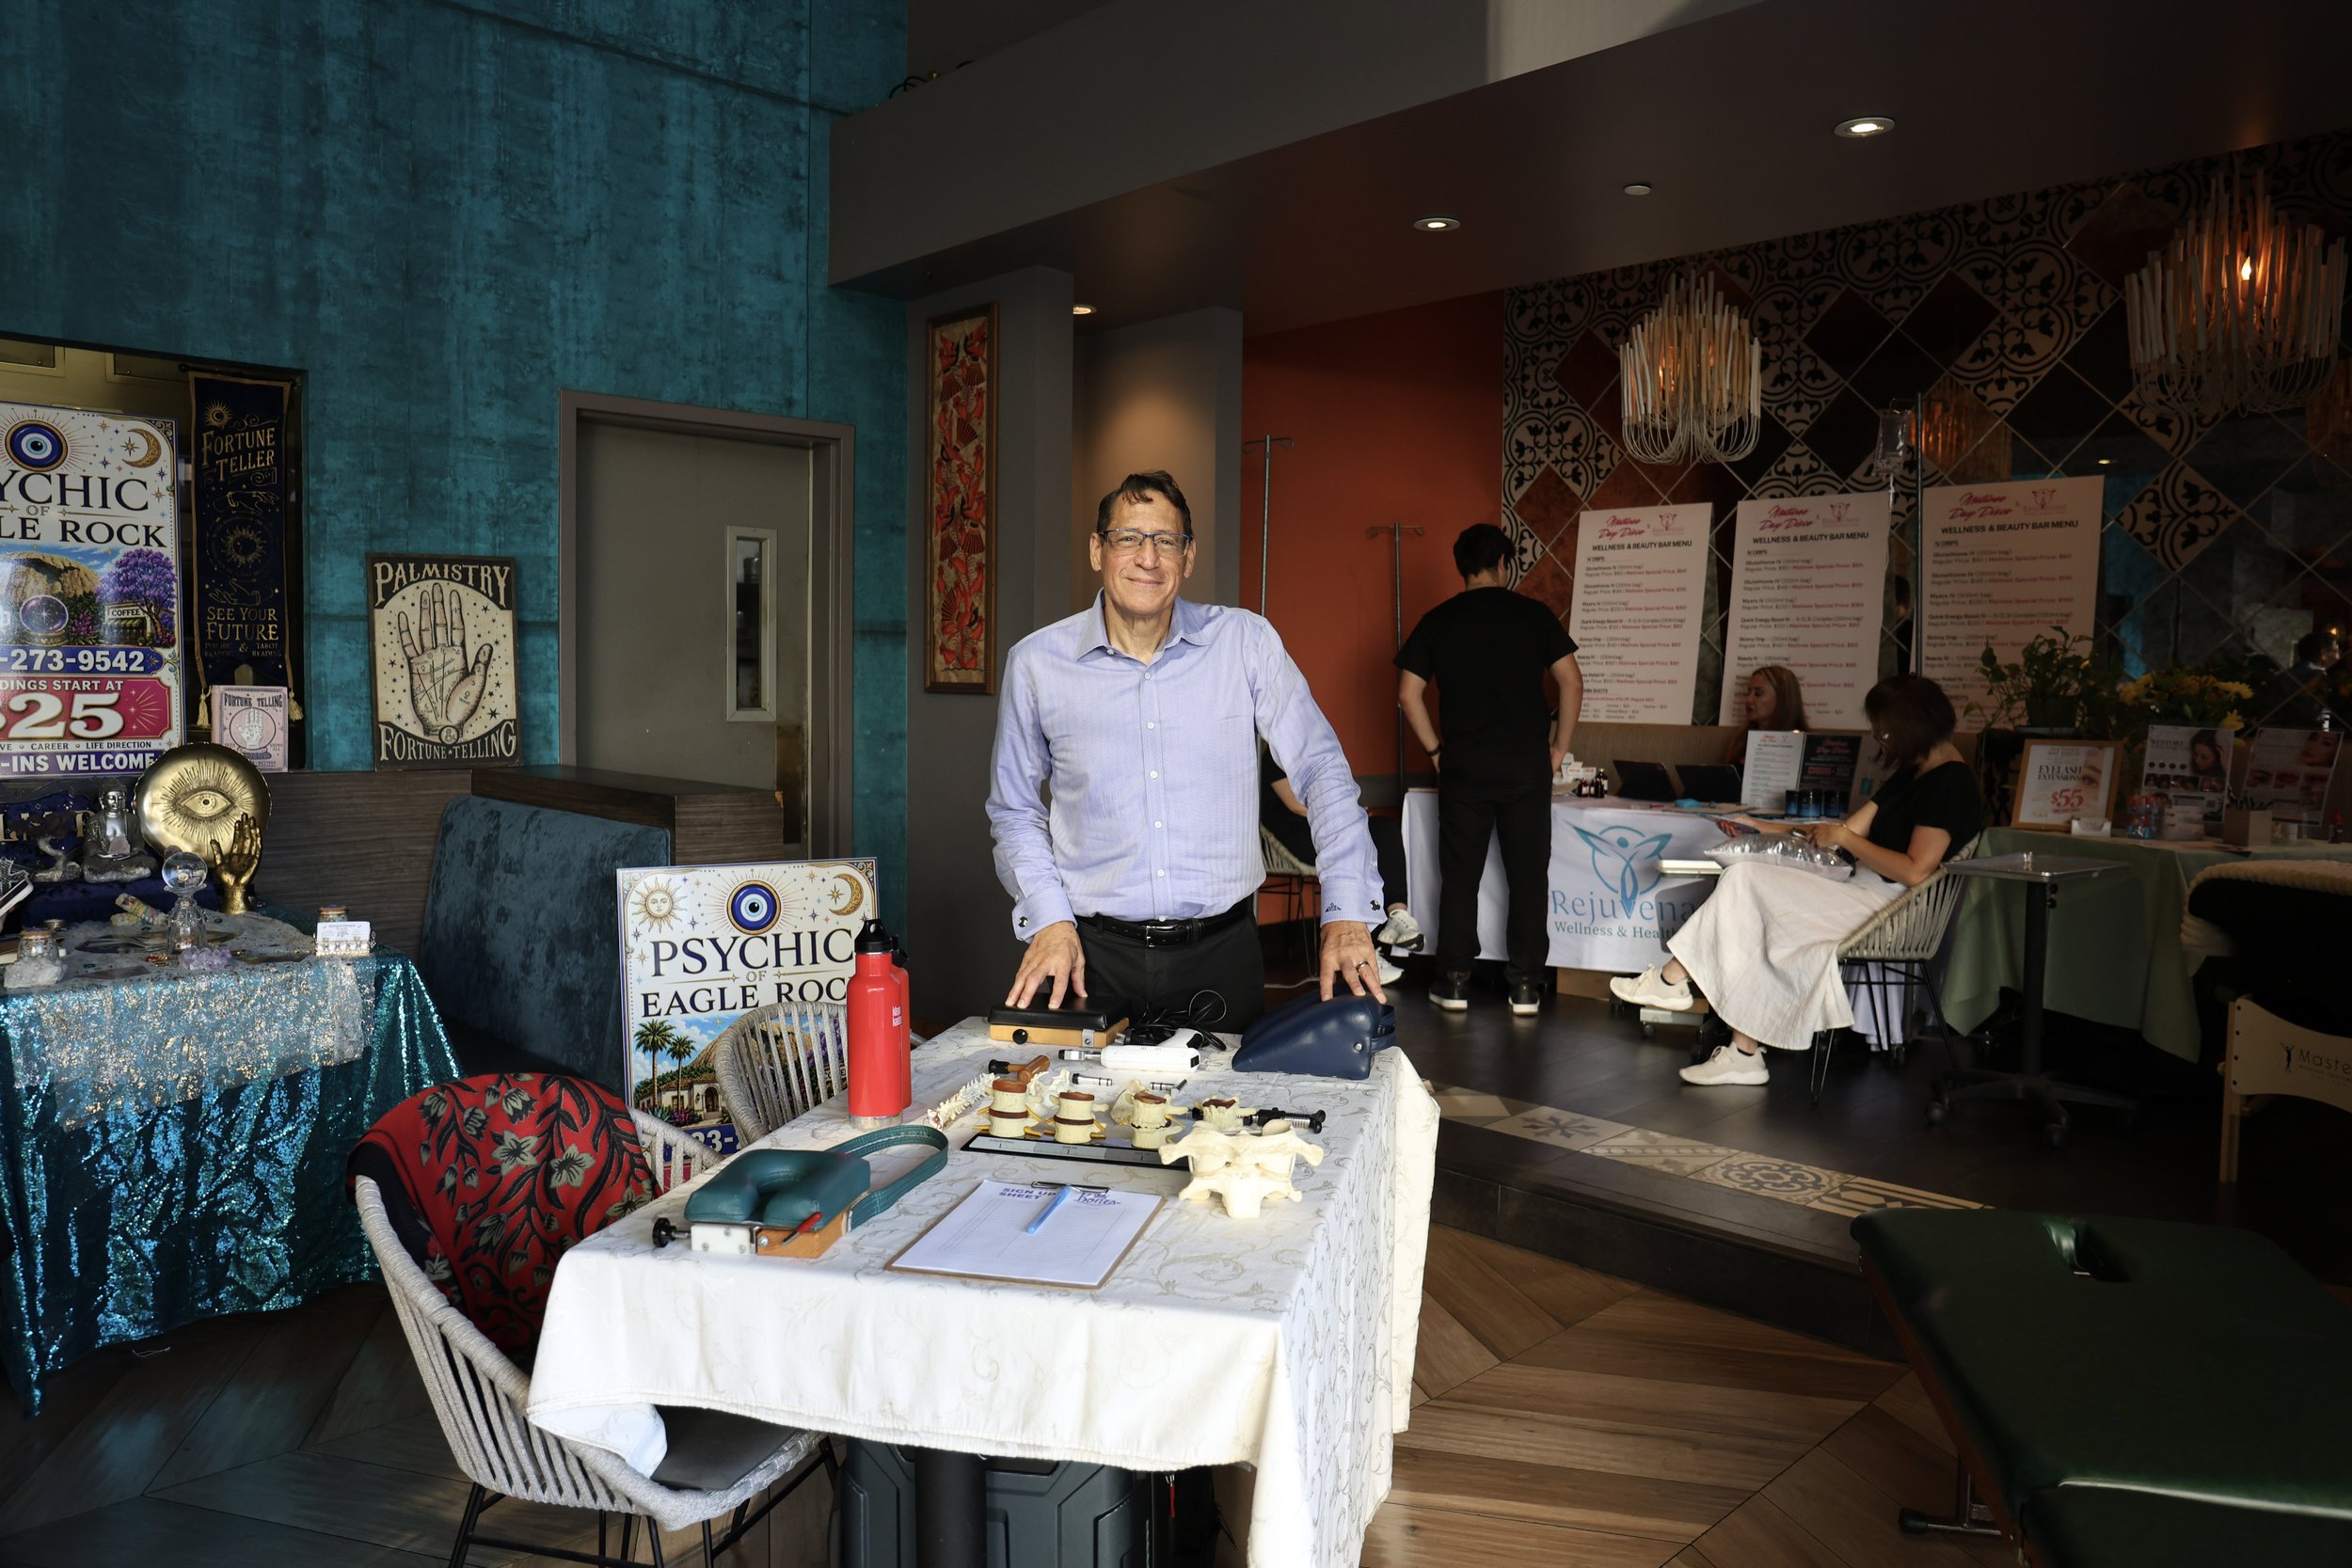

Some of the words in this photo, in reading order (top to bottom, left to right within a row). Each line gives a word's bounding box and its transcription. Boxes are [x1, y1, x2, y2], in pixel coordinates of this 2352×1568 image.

[201, 427, 277, 467] FORTUNE
[215, 449, 276, 482] TELLER
[26, 505, 50, 515] OF
[58, 519, 167, 547] ROCK
[1941, 526, 1986, 534] WELLNESS
[1995, 523, 2030, 532] BEAUTY
[2051, 520, 2078, 529] MENU
[1632, 541, 1658, 550] BEAUTY
[1658, 540, 1672, 548] BAR
[1752, 534, 1791, 544] WELLNESS
[1799, 533, 1828, 543] BEAUTY
[1829, 532, 1844, 541] BAR
[1845, 531, 1869, 540] MENU
[373, 561, 512, 609] PALMISTRY
[111, 608, 141, 617] COFFEE
[206, 606, 235, 622] SEE
[240, 607, 278, 622] YOUR
[205, 622, 279, 642] FUTURE
[238, 642, 249, 653] &
[52, 680, 101, 691] START
[105, 680, 123, 691] AT
[224, 692, 253, 707] FORTUNE
[257, 694, 283, 707] TELLING
[30, 742, 70, 751] CAREER
[107, 741, 151, 750] DIRECTION
[378, 723, 447, 762] FORTUNE
[453, 721, 516, 760] TELLING
[56, 752, 154, 773] WELCOME
[2039, 765, 2082, 774] EYELASH
[2051, 788, 2084, 807] $55
[1554, 921, 1613, 937] Wellness
[1616, 926, 1627, 938] &
[650, 927, 854, 977] PSYCHIC
[746, 970, 767, 983] OF
[642, 984, 760, 1018] EAGLE
[775, 977, 850, 1004] ROC
[997, 1192, 1041, 1200] SHEET
